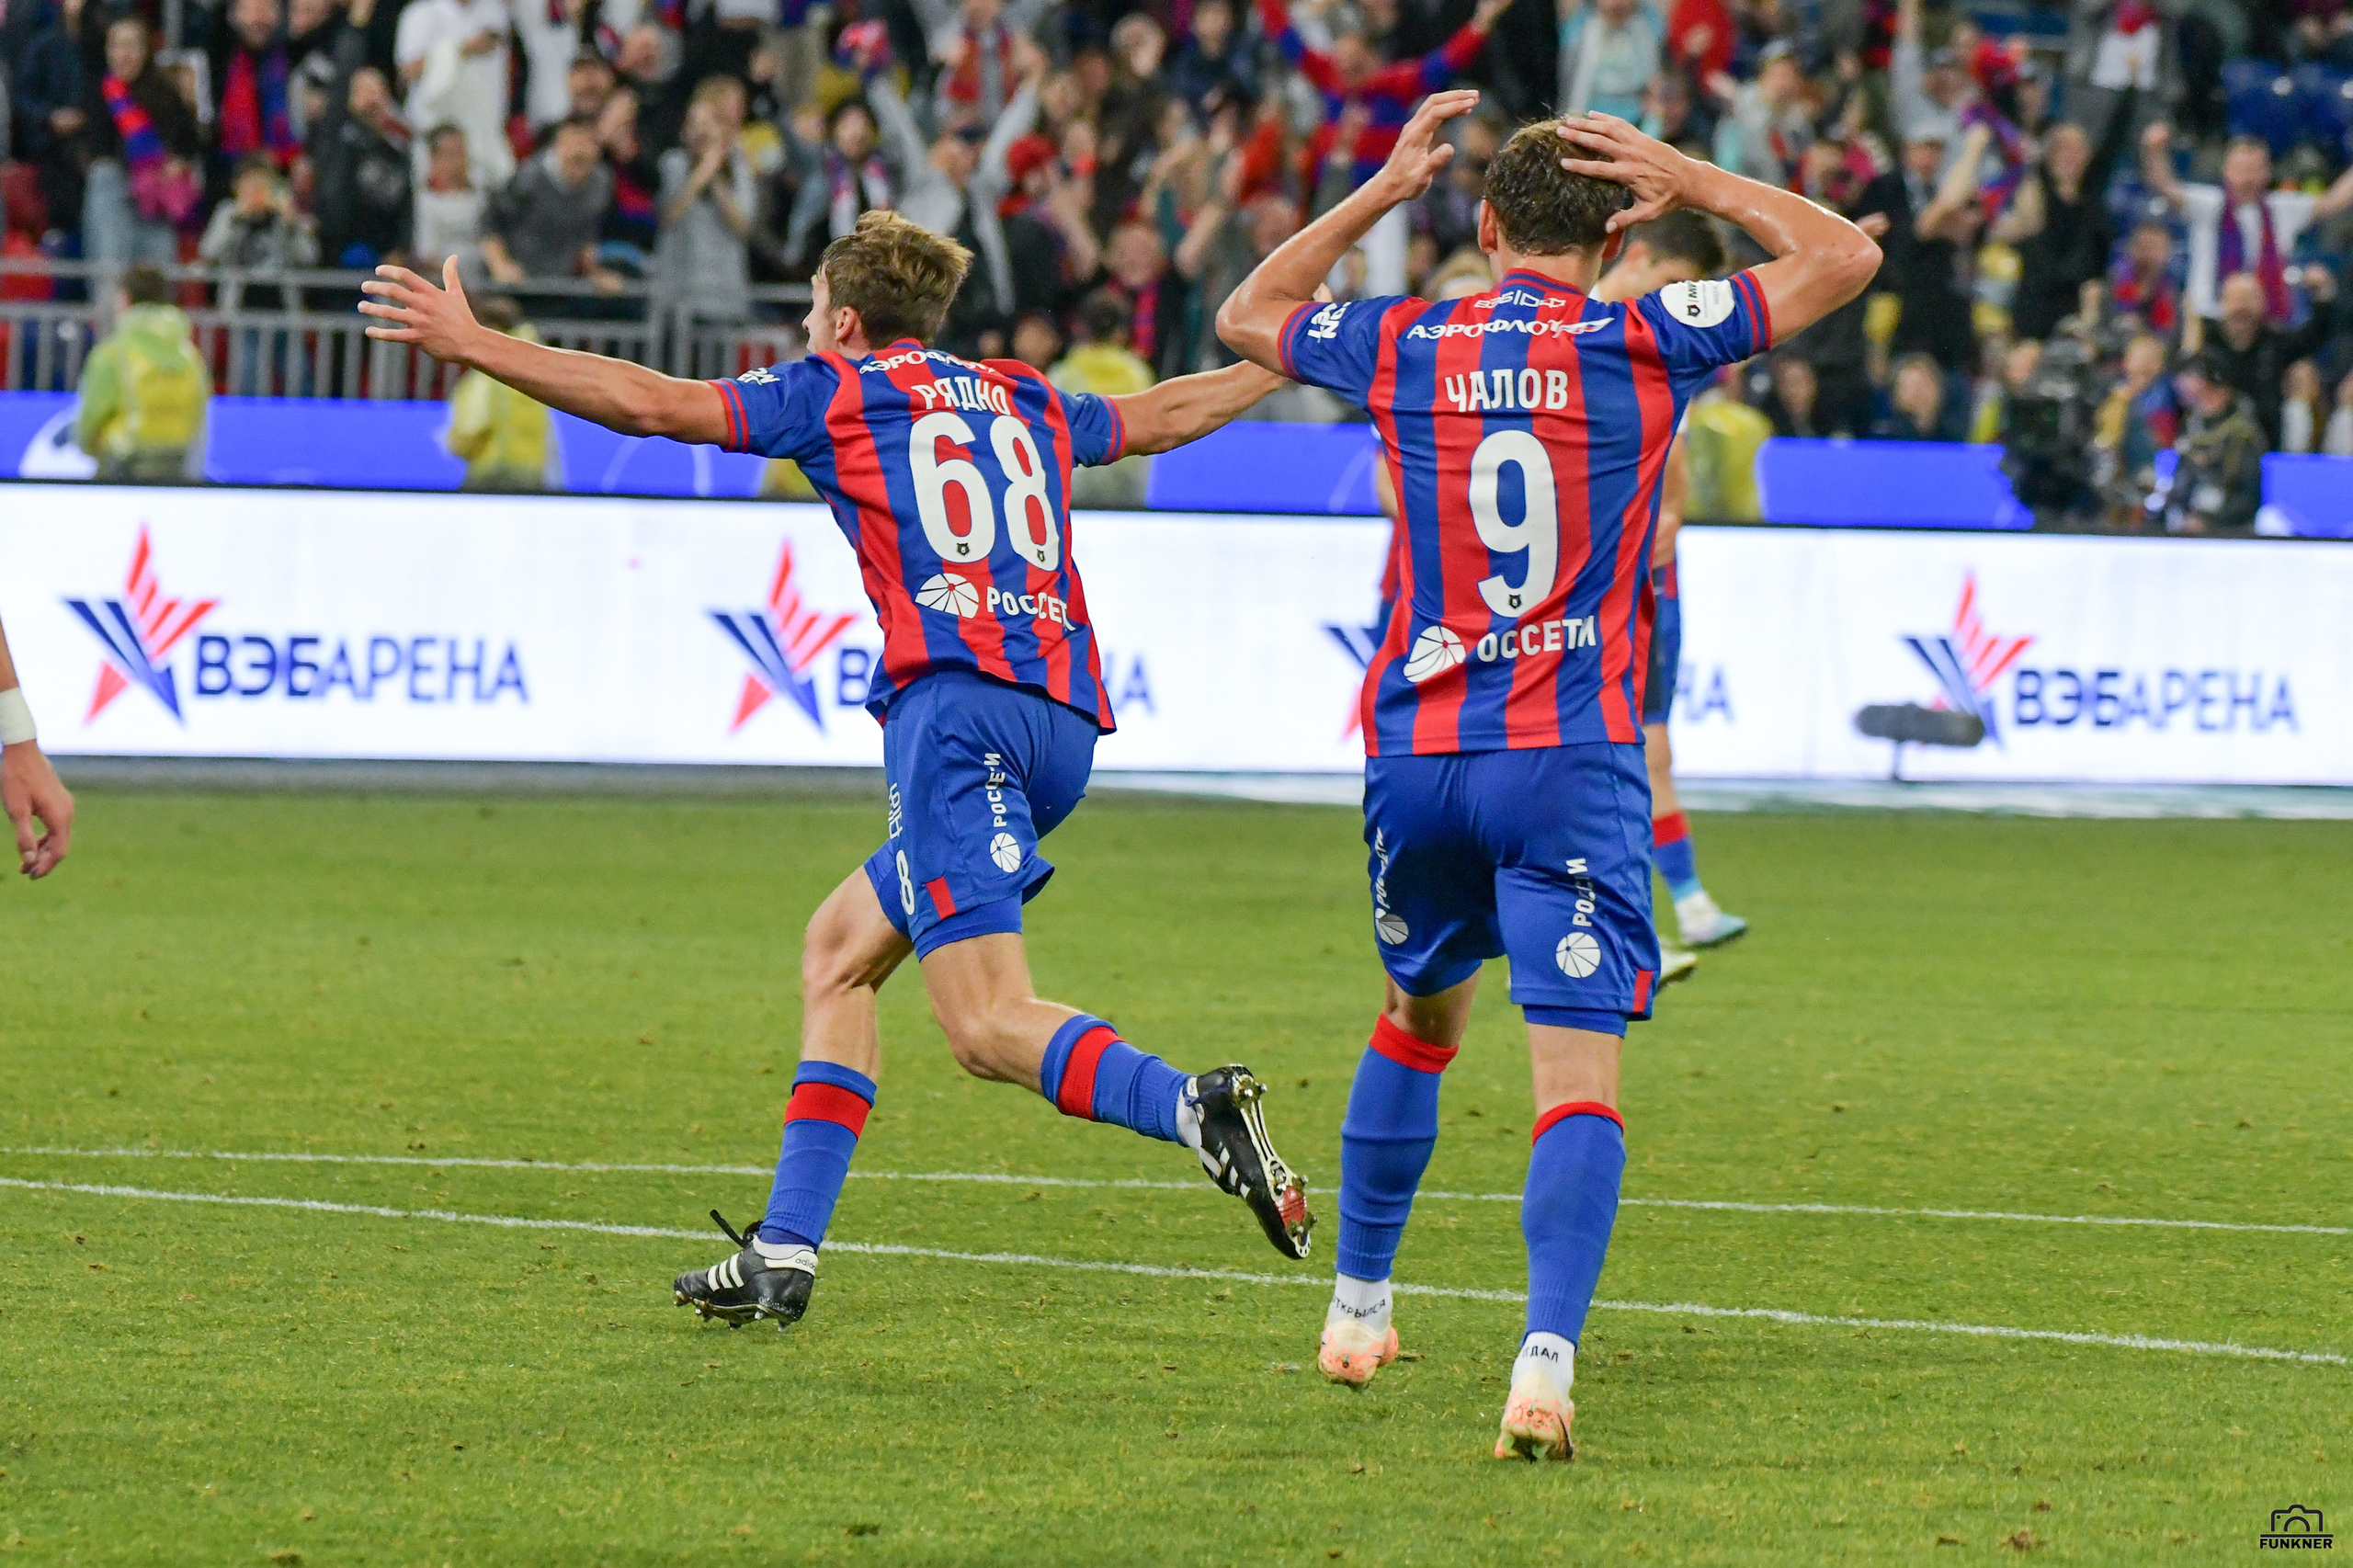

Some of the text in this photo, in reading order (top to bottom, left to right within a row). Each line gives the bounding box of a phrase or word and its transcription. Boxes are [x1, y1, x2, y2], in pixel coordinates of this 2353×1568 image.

[910, 376, 1011, 415] РЯДНО
[1444, 368, 1569, 413] ЧАЛОВ
[908, 411, 1060, 572] 68
[1469, 429, 1559, 619] 9
[986, 585, 1076, 632] РОССЕТ
[1476, 615, 1597, 663] ОССЕТИ
